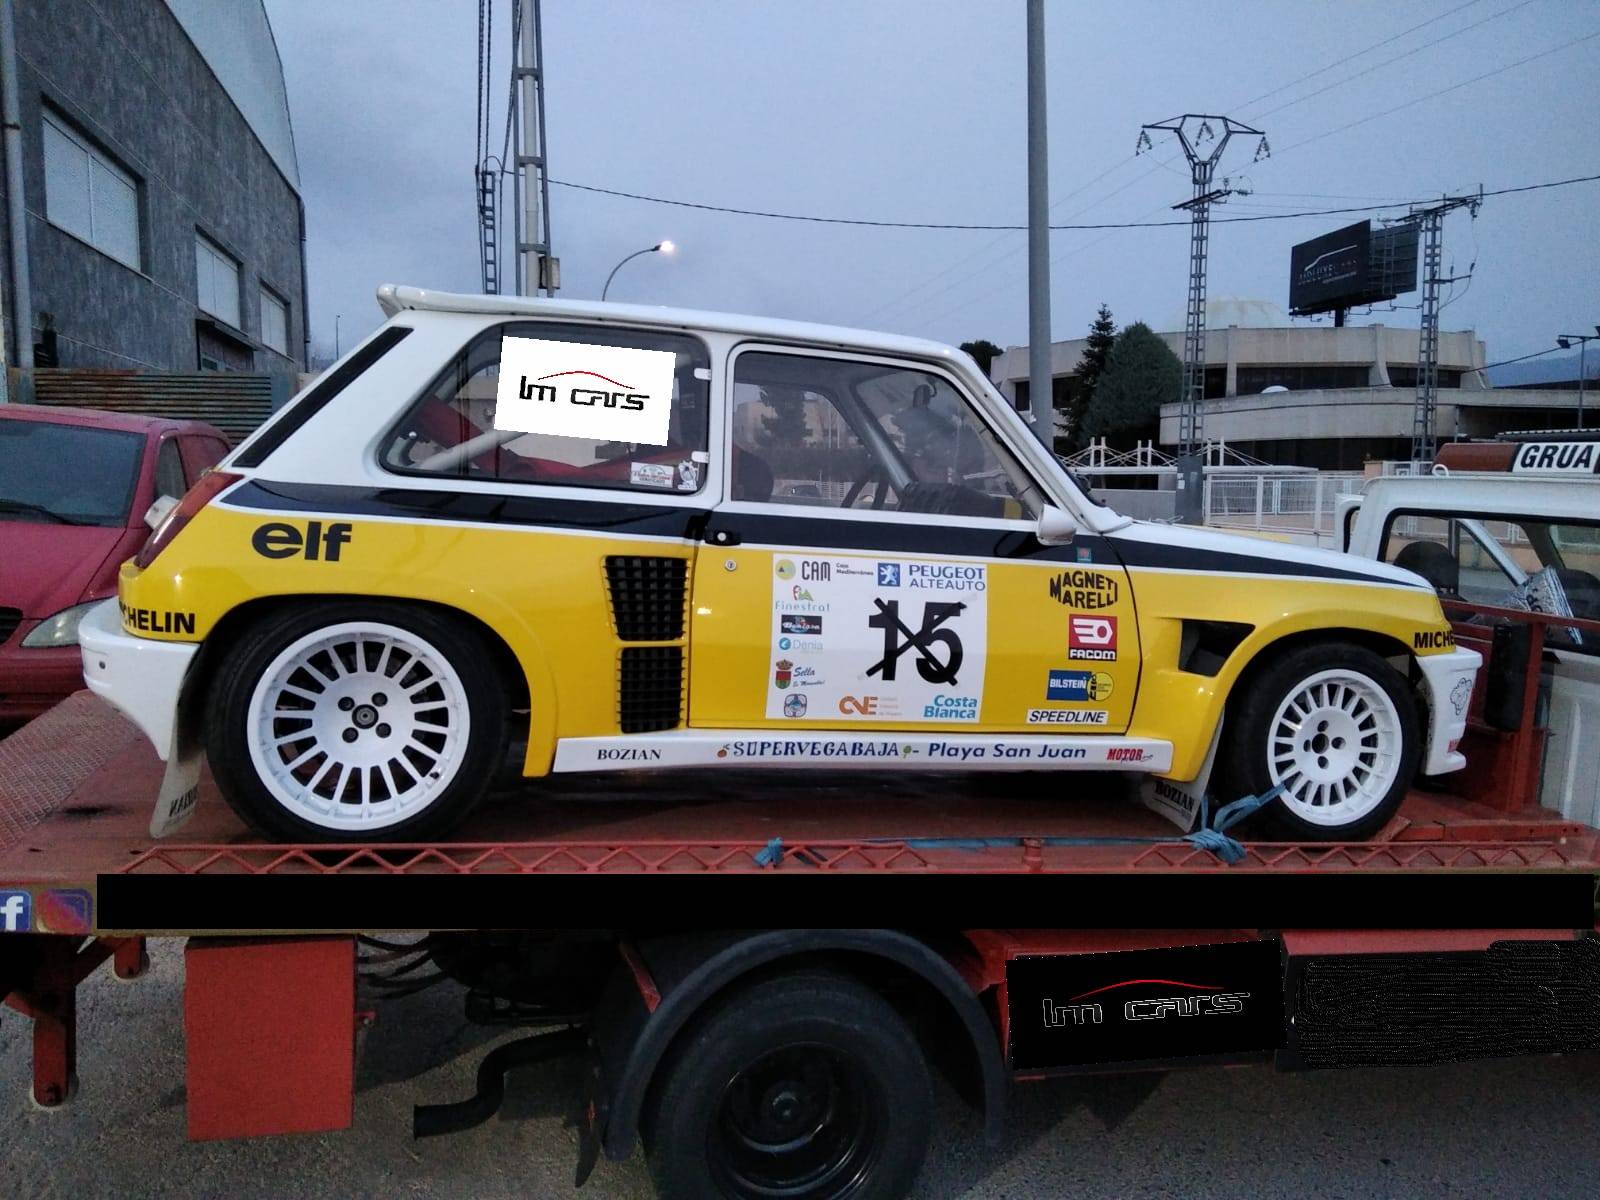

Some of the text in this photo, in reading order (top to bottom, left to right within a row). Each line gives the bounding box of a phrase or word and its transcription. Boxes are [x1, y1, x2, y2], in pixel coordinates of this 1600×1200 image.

[1521, 445, 1594, 468] GRUA
[252, 521, 352, 561] elf
[801, 561, 831, 581] CAM
[909, 564, 985, 581] PEUGEOT
[909, 578, 985, 591] ALTEAUTO
[868, 599, 964, 685] 15
[1050, 678, 1087, 689] BILSTEIN
[934, 694, 977, 708] Costa
[923, 705, 976, 719] Blanca
[1029, 710, 1106, 723] SPEEDLINE
[597, 748, 662, 760] BOZIAN
[928, 743, 985, 760] Playa
[992, 743, 1031, 758] San
[1037, 744, 1086, 758] Juan
[1107, 749, 1144, 761] MOTOR
